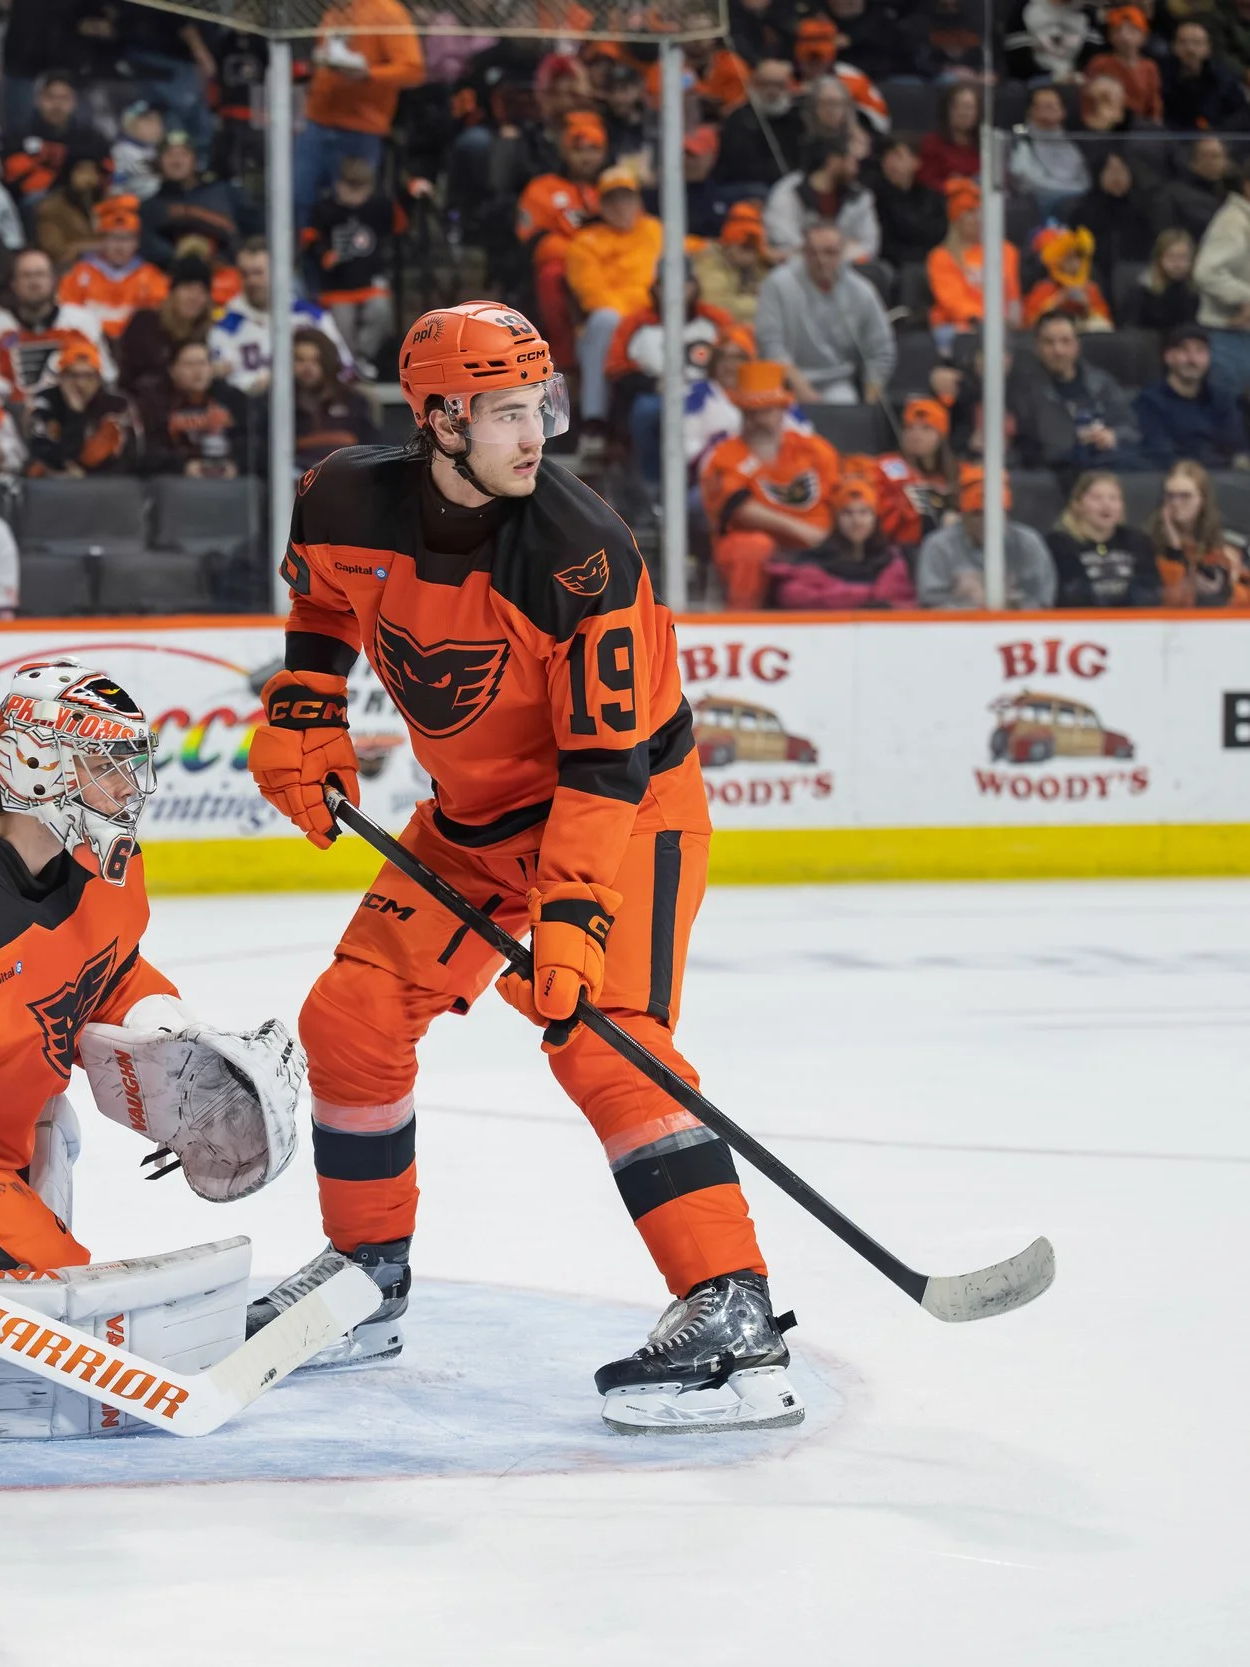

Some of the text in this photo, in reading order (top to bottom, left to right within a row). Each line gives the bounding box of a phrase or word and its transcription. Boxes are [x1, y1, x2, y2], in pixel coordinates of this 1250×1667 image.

[412, 324, 434, 345] ppl
[516, 349, 546, 363] CCM
[334, 561, 373, 575] Capital
[680, 642, 791, 683] BIG
[996, 638, 1108, 680] BIG
[566, 626, 637, 735] 19
[5, 694, 137, 740] PHNTOMS
[270, 700, 348, 723] CCM
[705, 771, 833, 806] OODY'S
[974, 766, 1150, 802] WOODY'S
[362, 893, 416, 922] CM
[543, 969, 557, 997] CCM
[113, 1048, 148, 1132] VAUGHN
